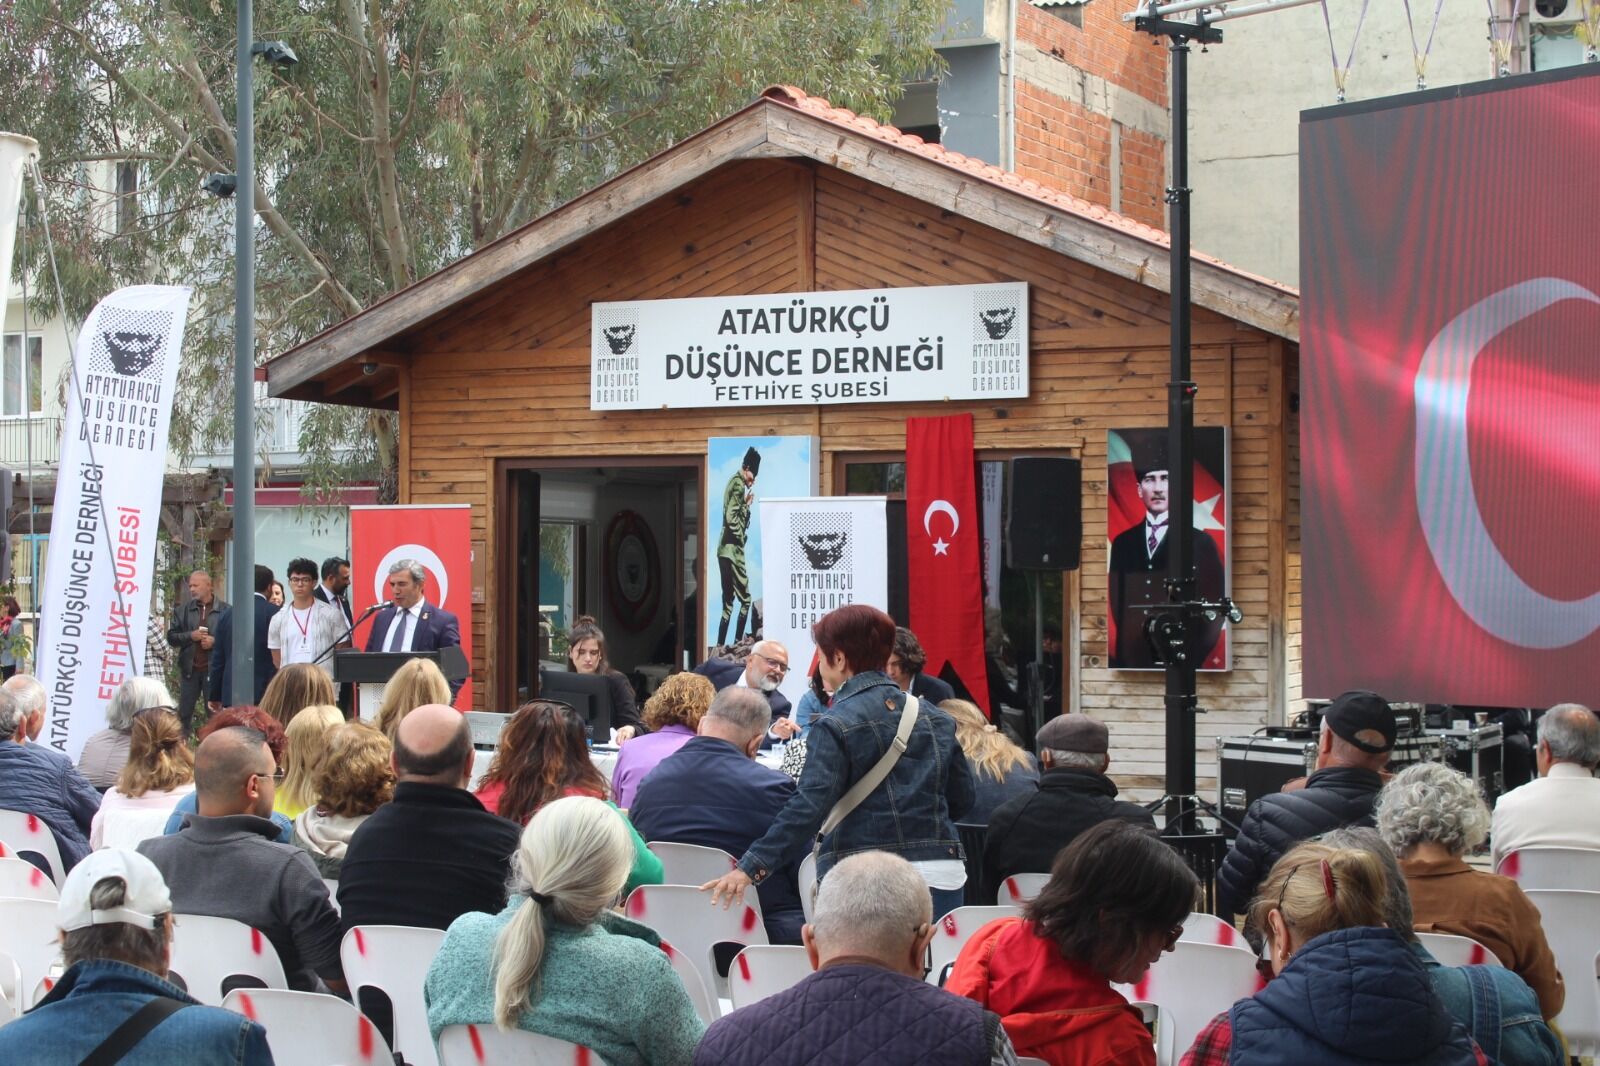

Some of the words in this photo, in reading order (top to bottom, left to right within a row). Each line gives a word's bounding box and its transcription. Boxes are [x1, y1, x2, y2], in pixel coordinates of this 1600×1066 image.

[718, 296, 889, 338] ATATÜRKÇÜ
[666, 344, 802, 385] DÜŞÜNCE
[813, 336, 943, 374] DERNEĞİ
[86, 374, 162, 403] ATATÜRKÇÜ
[715, 380, 803, 401] FETHİYE
[811, 376, 888, 402] ŞUBESİ
[83, 396, 158, 428] DÜŞÜNCE
[80, 420, 155, 451] DERNEĞİ
[75, 462, 104, 545] DERNEĞİ
[114, 506, 141, 595] ŞUBESİ
[60, 549, 93, 637] DÜŞÜNCE
[790, 570, 853, 590] ATATÜRKÇÜ
[98, 601, 132, 700] FETHİYE
[50, 643, 82, 752] ATATÜRKÇÜ
